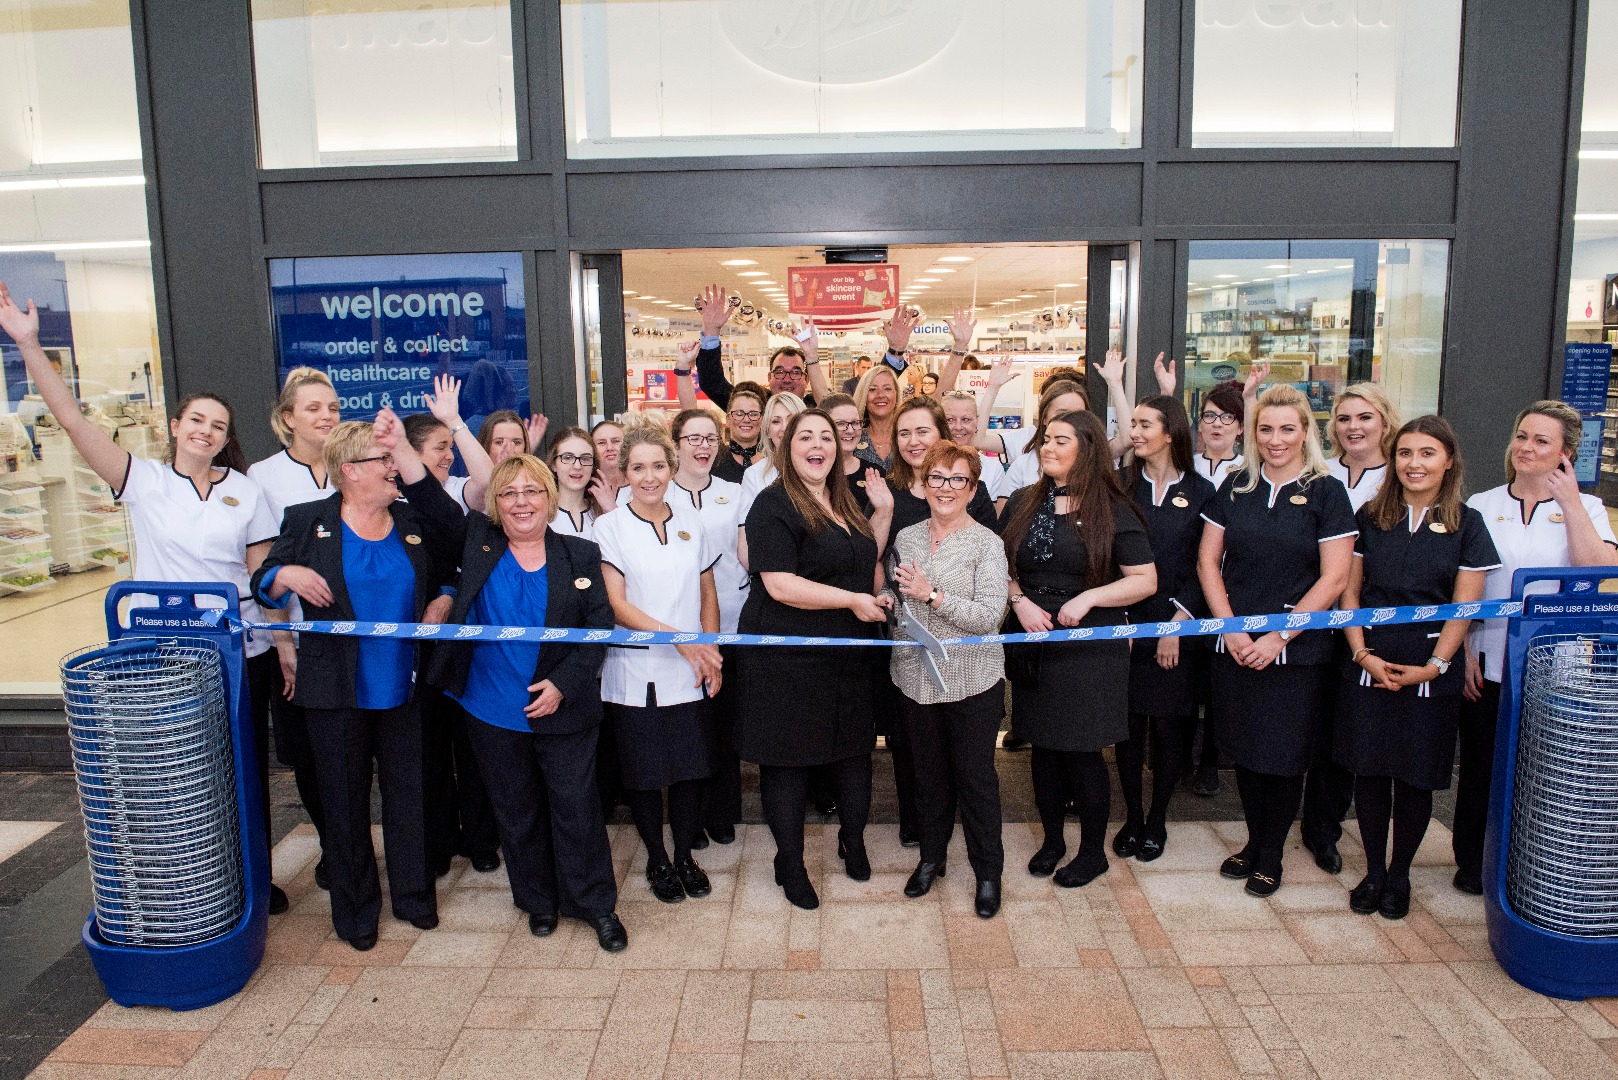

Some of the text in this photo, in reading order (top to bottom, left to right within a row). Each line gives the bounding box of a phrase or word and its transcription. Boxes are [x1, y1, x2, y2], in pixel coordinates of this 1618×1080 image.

[844, 276, 854, 285] big
[825, 284, 862, 293] skincare
[832, 293, 856, 301] event
[321, 286, 485, 320] welcome
[913, 323, 949, 334] dicine
[325, 335, 469, 356] order & collect
[1567, 347, 1591, 355] opening
[327, 364, 431, 382] healthcare
[1033, 370, 1052, 378] sav
[969, 379, 989, 389] only
[338, 391, 374, 410] ood
[380, 392, 394, 409] &
[1533, 602, 1618, 614] Please use a baske
[135, 616, 164, 627] Please
[165, 619, 181, 627] use
[182, 619, 188, 627] a
[331, 622, 356, 634] Boots
[370, 623, 399, 635] Boots
[412, 624, 441, 636] Boots
[454, 625, 484, 637] Boots
[497, 627, 527, 639] Boots
[539, 628, 569, 640] Boots
[583, 630, 612, 641] Boots
[627, 632, 655, 642] Boots
[670, 633, 699, 643] Boots
[714, 634, 743, 643] Boots
[1024, 631, 1050, 641] Boots
[1068, 628, 1094, 639] Boots
[1112, 624, 1138, 637] Boots
[1156, 621, 1182, 635] Boots
[1199, 618, 1225, 633] Boots
[1242, 615, 1269, 630] Boots
[1285, 612, 1312, 628] Boots
[1328, 609, 1354, 626] Boots
[1370, 607, 1397, 623] Boots
[1412, 605, 1439, 620] Boots
[1454, 602, 1482, 618] Boots
